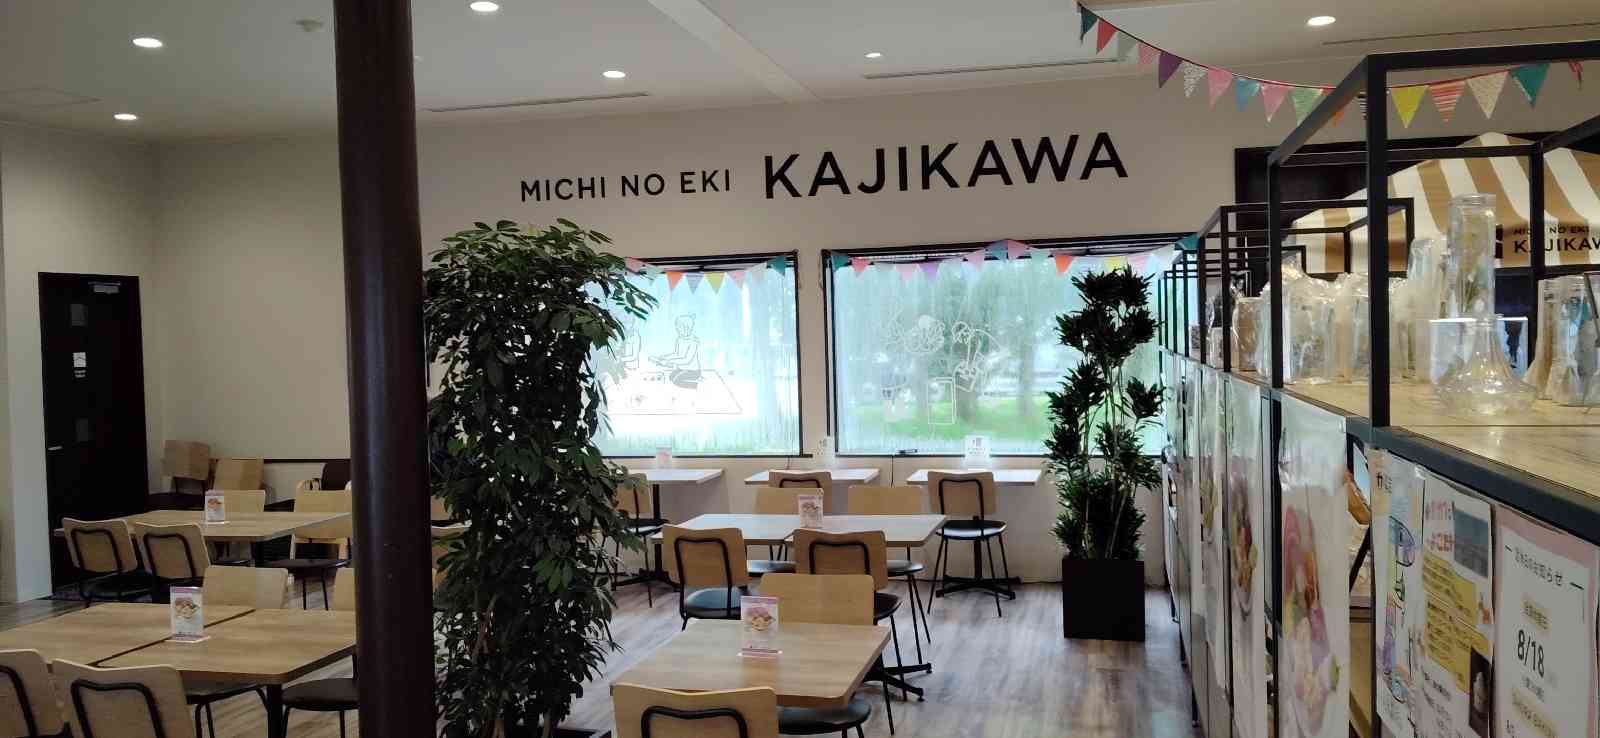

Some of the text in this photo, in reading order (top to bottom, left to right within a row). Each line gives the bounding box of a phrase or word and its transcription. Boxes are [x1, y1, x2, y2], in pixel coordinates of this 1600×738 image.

[520, 132, 1128, 203] MICHI NO EKI KAJIKAWA
[1517, 629, 1545, 679] 8/18
